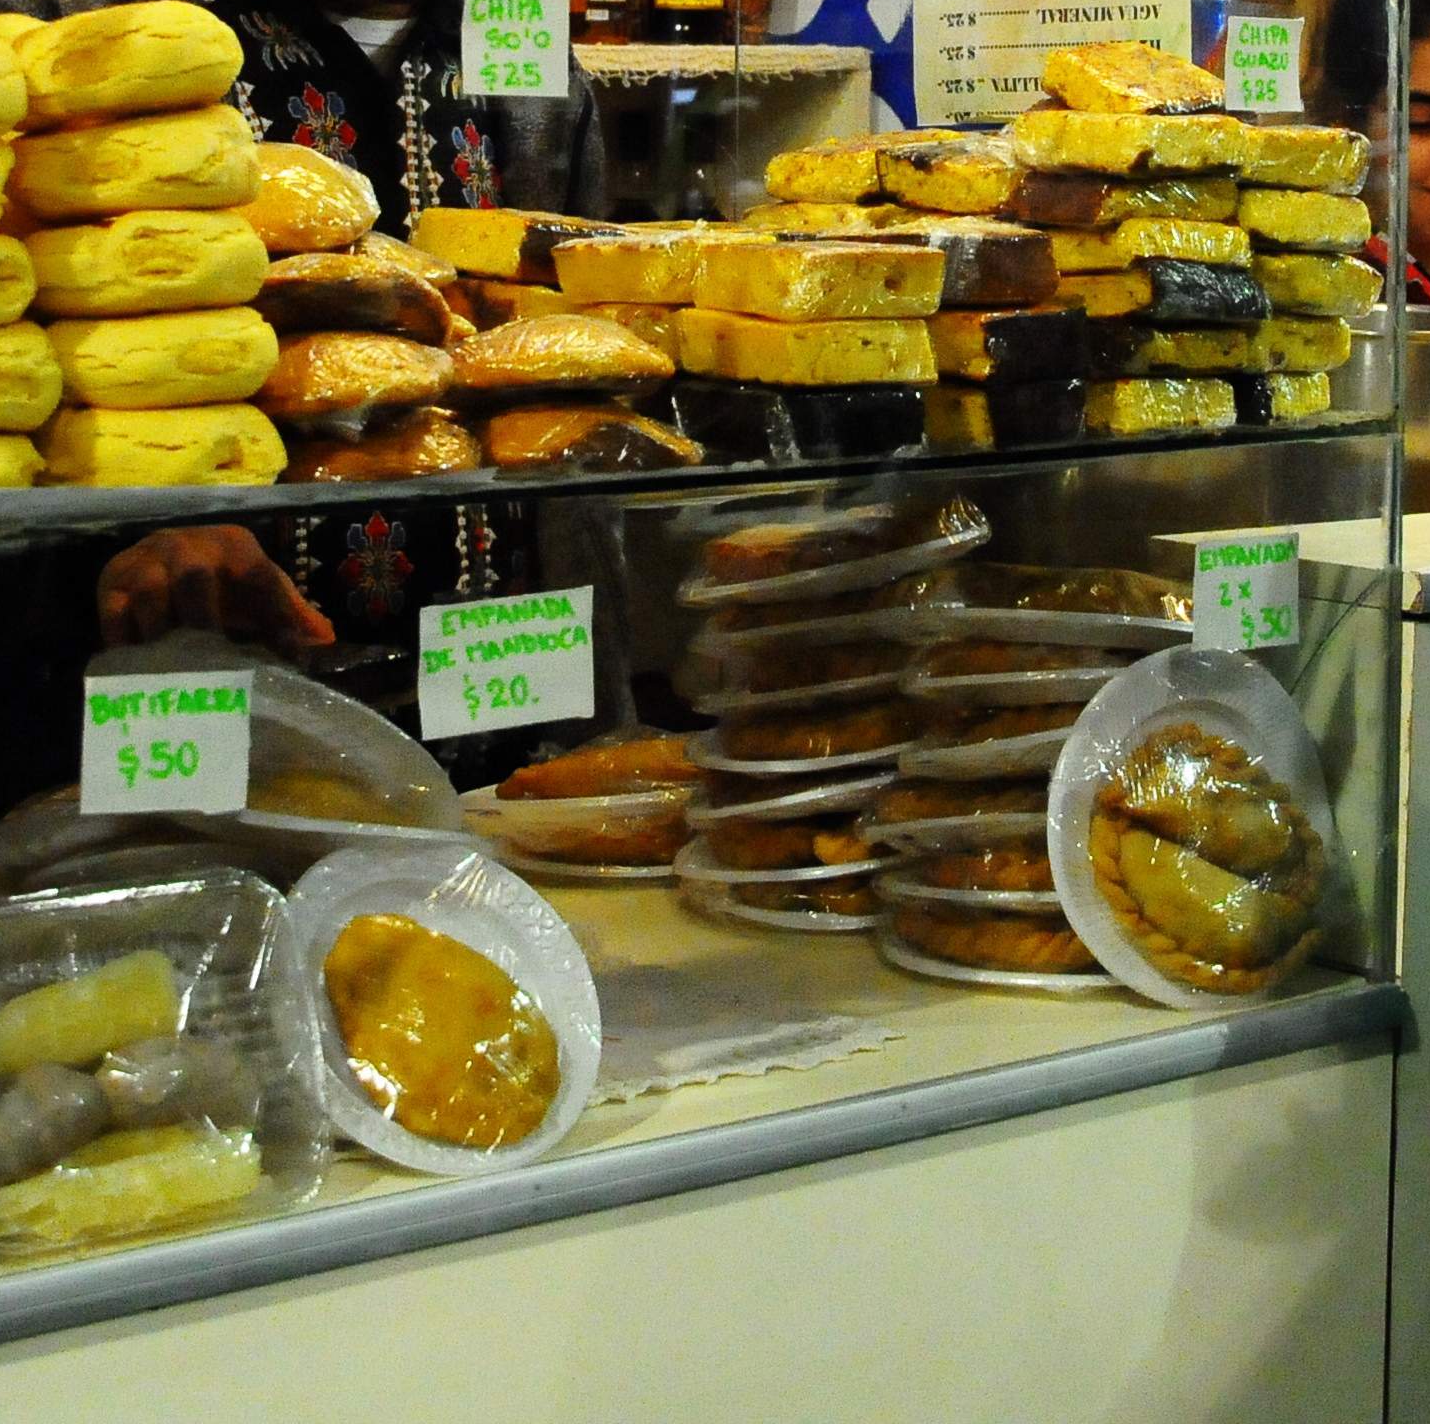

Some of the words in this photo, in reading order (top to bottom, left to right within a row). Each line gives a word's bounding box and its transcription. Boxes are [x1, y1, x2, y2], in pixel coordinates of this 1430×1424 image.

[1035, 6, 1118, 24] MINERAL
[1119, 3, 1162, 19] AGUA
[1238, 22, 1289, 46] CHIPA
[441, 596, 577, 637] EMPANADA
[422, 647, 457, 674] DE
[465, 625, 589, 663] MANDIOCA
[89, 687, 249, 726] BUTIFARRA
